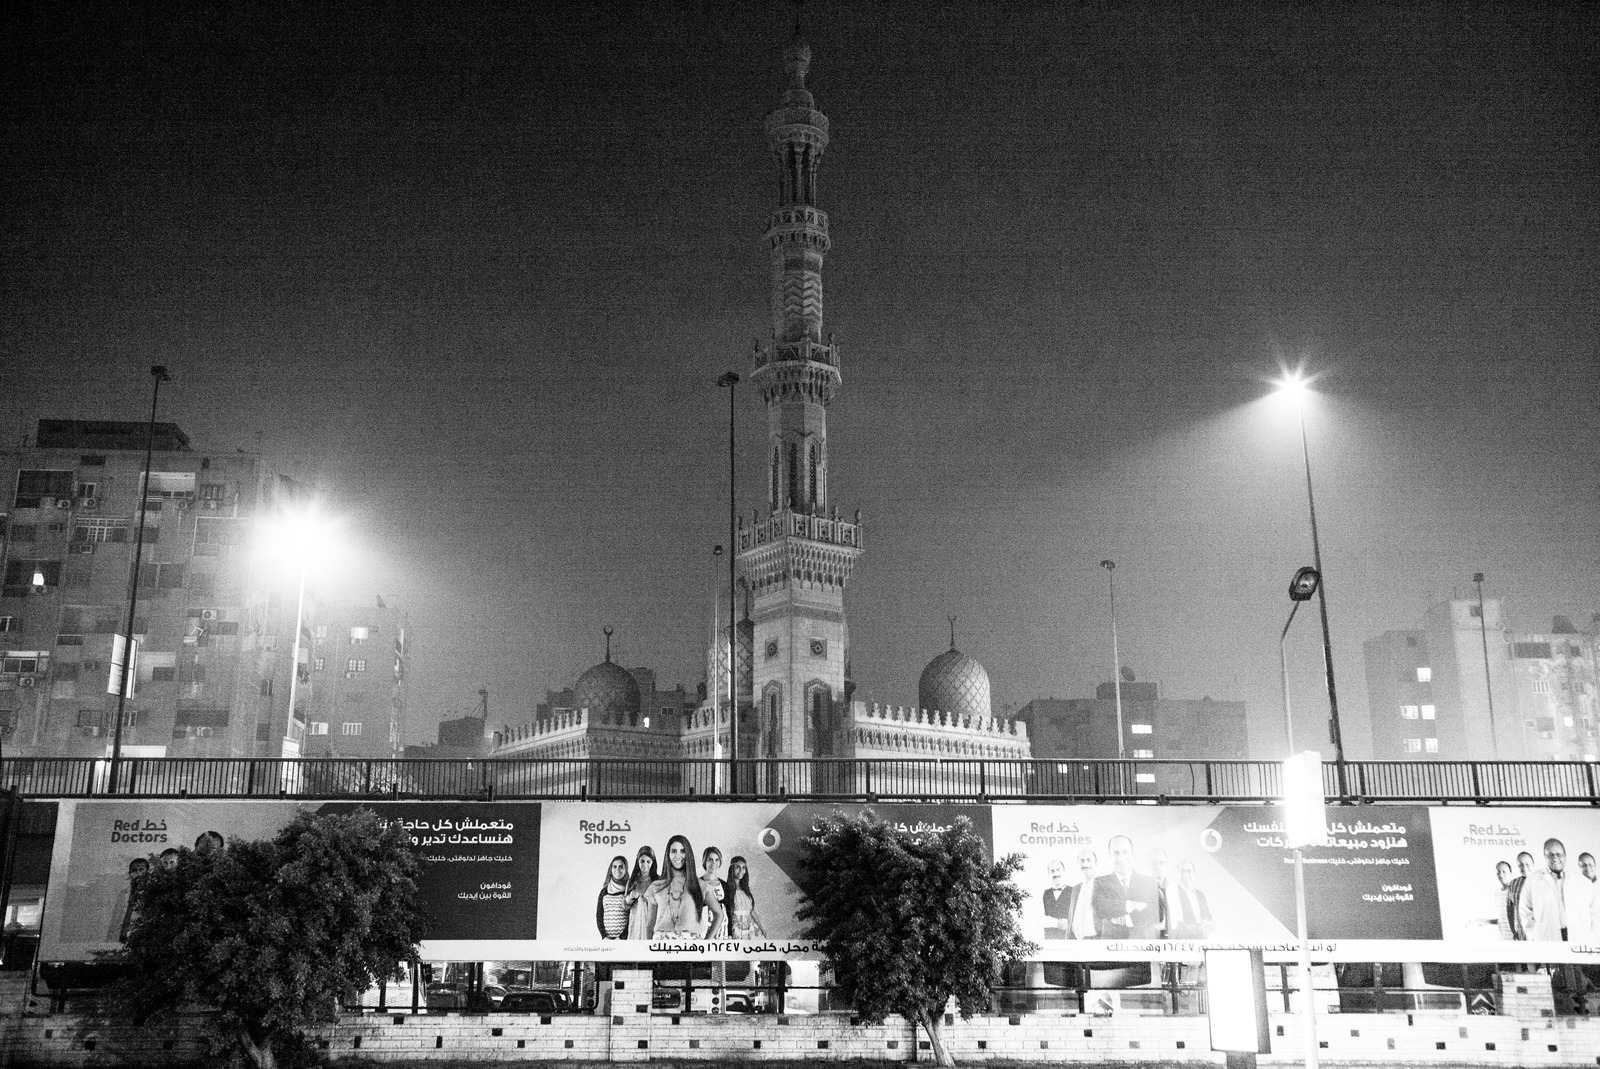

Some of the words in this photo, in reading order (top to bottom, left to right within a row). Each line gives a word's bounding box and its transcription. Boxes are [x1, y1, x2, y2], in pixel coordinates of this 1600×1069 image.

[114, 819, 140, 831] Red
[141, 819, 167, 831] خط
[432, 819, 453, 832] كل
[455, 817, 514, 831] متعملش
[579, 819, 605, 832] Red
[605, 819, 632, 832] خط
[1030, 822, 1054, 833] Red
[1056, 822, 1079, 833] خط
[1243, 821, 1288, 832] نفسك
[1326, 822, 1347, 835] كل
[1347, 820, 1407, 835] متعملش
[1469, 824, 1493, 836] Red
[1495, 824, 1521, 836] خط
[110, 831, 168, 843] Doctors
[421, 833, 446, 846] تدير
[448, 833, 513, 844] هنساعدك
[584, 832, 627, 848] Shops
[1019, 833, 1092, 847] Companies
[1463, 836, 1527, 846] Pharmacies
[1369, 837, 1408, 850] هنزود
[479, 891, 492, 901] بين
[492, 891, 512, 901] القوة
[648, 942, 705, 954] وهنجيلك
[707, 942, 740, 952] ١٦٢٤٧
